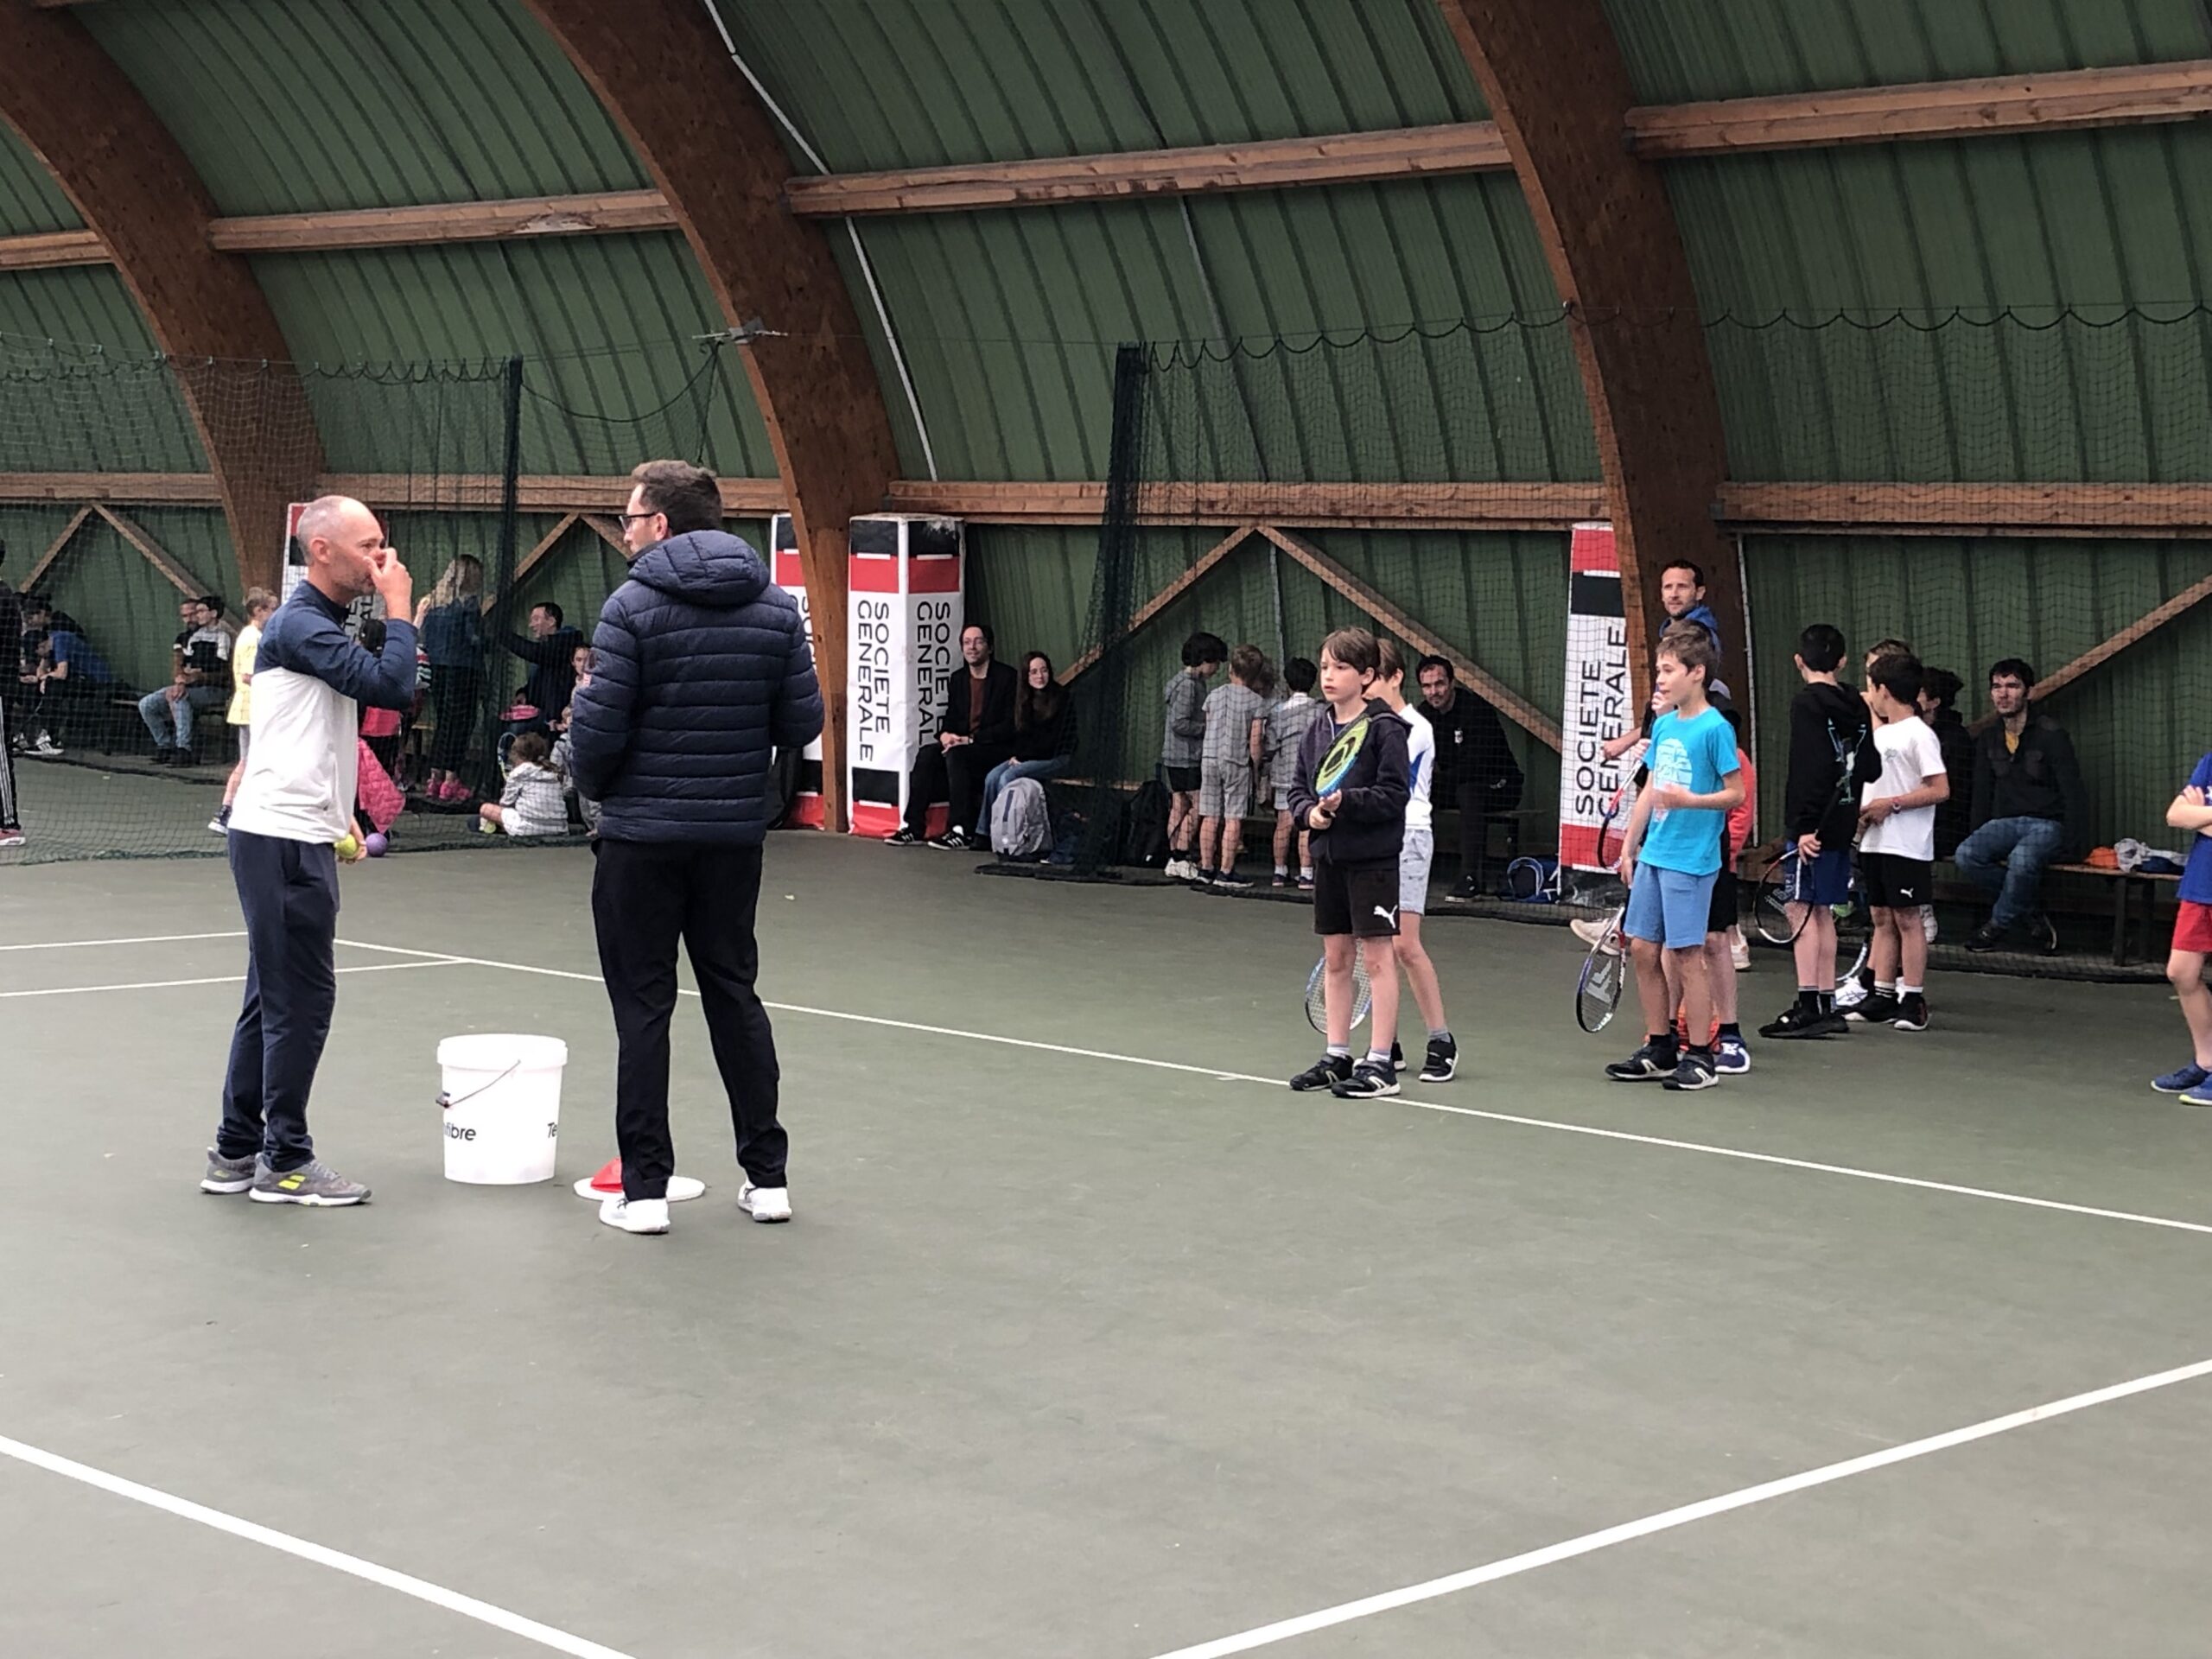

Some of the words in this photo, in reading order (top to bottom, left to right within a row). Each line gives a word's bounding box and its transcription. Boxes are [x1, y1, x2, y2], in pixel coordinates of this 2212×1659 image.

[857, 600, 874, 762] GENERALE
[874, 602, 890, 734] SOCIETE
[917, 601, 934, 746] GENERAL
[1575, 659, 1601, 816] SOCIETE
